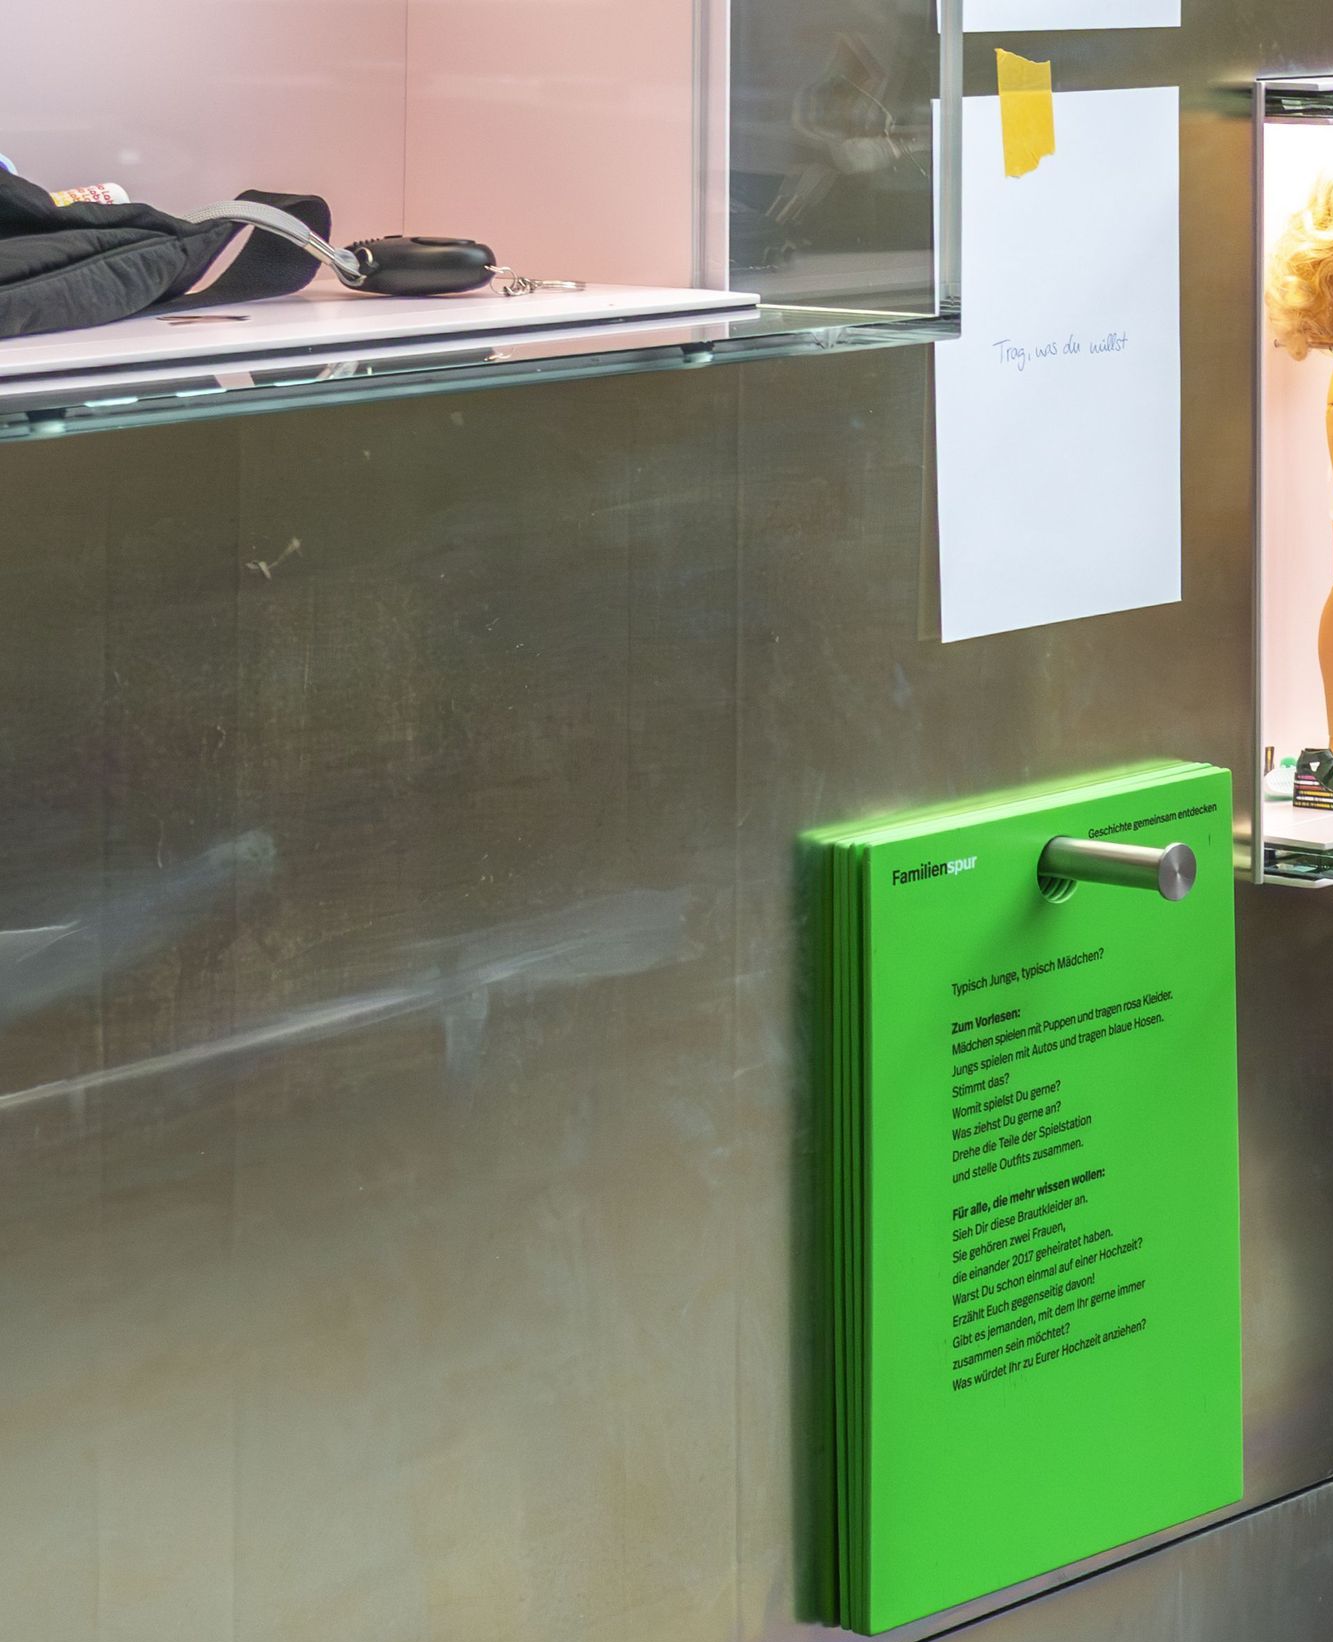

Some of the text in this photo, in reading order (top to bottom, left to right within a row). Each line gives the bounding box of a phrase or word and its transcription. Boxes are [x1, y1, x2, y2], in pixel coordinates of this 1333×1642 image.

[992, 338, 1031, 372] Trag,
[1035, 341, 1058, 358] was
[1062, 334, 1081, 355] du
[1088, 802, 1217, 839] Geschichte gemeinsam entdecken
[892, 853, 977, 886] Familienspur
[951, 947, 1104, 996] Typisch Junge, typisch Mädchen?
[951, 1008, 1020, 1034] Zum Vorlesen:
[951, 990, 1173, 1055] Mädchen spielen mit Puppen und tragen rosa Kleider.
[951, 1013, 1164, 1077] Jungs spielen mit Autos und tragen blaue Hosen.
[951, 1072, 1009, 1098] Stimmt das?
[951, 1079, 1061, 1119] Womit spielst Du gerne?
[951, 1100, 1061, 1140] Was ziehst Du gerne an?
[952, 1115, 1091, 1162] Drehe die Teile der Spielstation
[952, 1139, 1083, 1183] und stelle Outfits zusammen.
[952, 1168, 1105, 1220] Für alle, die mehr wissen wollen:
[952, 1194, 1088, 1241] Sieh Dir diese Brautkleider an.
[952, 1222, 1065, 1263] Sie gehören zwei Frauen,
[952, 1228, 1113, 1284] die einander 2017 geheiratet haben.
[951, 1237, 1143, 1305] Warst Du schon einmal auf einer Hochzeit?
[952, 1272, 1094, 1327] Erzählt Euch gegenseitig davon!
[952, 1279, 1145, 1348] Gibt es jemanden, mit dem Ihr gerne immer
[952, 1322, 1070, 1370] zusammen sein möchtet?
[952, 1318, 1146, 1391] Was würdet Ihr zu Eurer Hochzeit anziehen?
